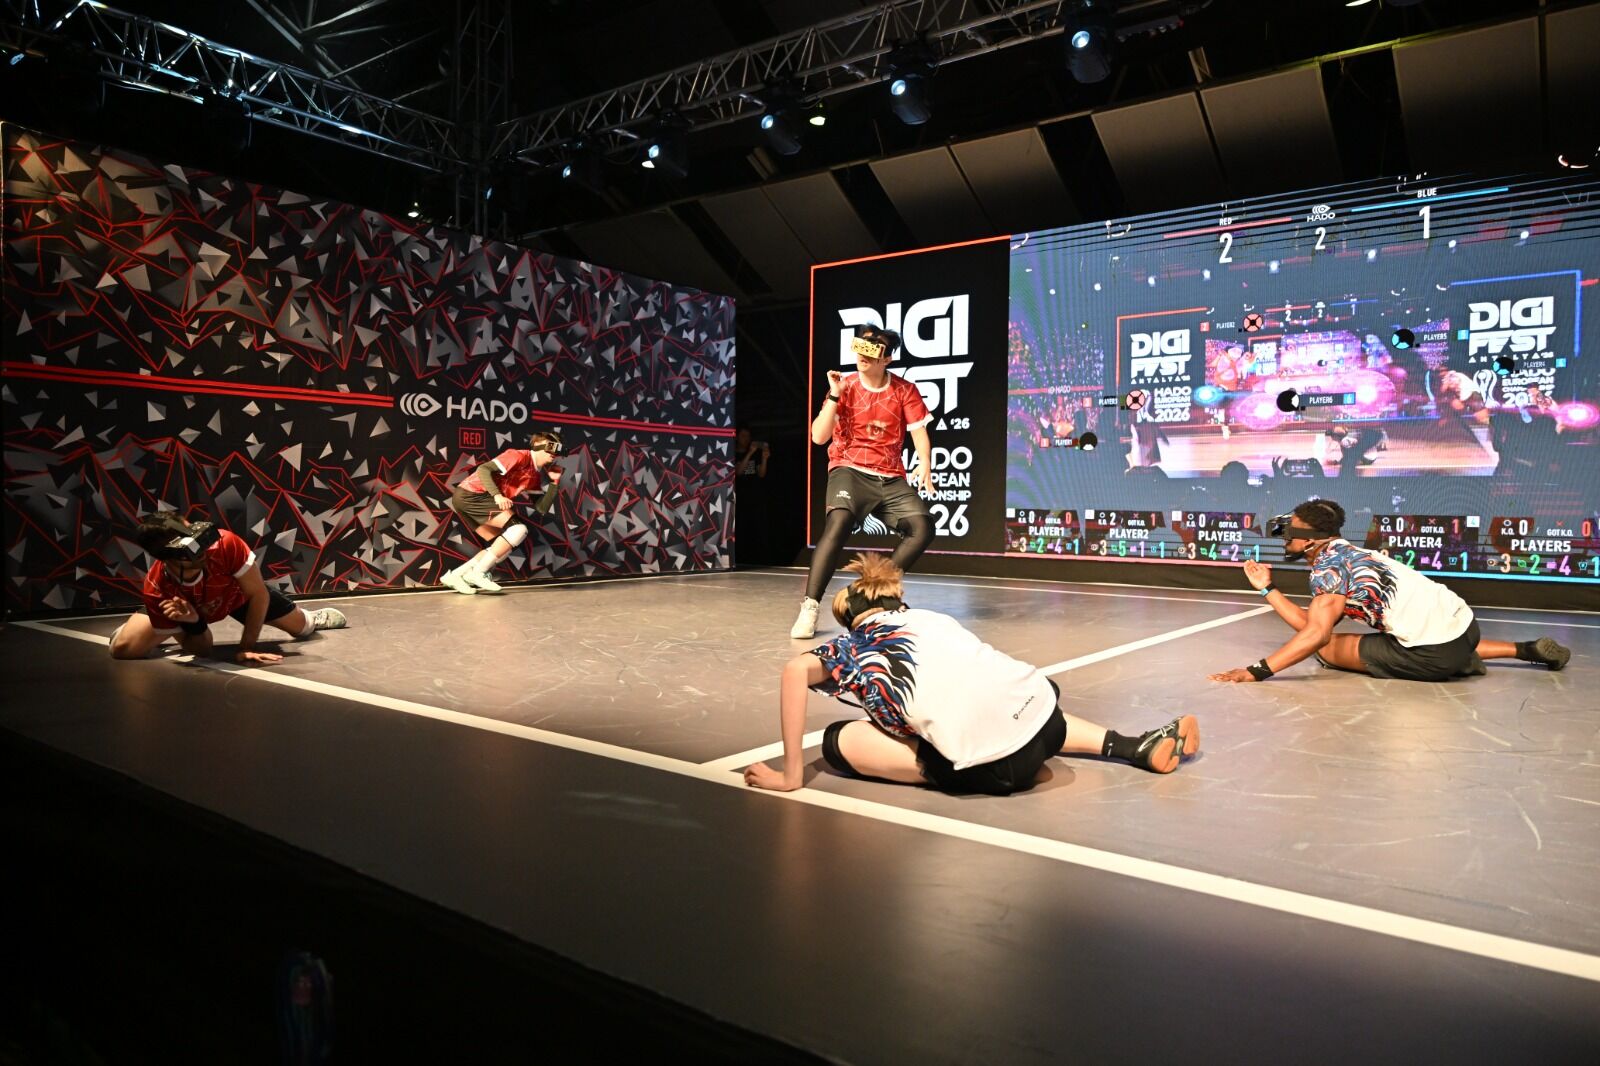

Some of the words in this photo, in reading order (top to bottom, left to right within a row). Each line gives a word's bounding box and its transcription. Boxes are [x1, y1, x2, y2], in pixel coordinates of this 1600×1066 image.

[1417, 188, 1437, 198] BLUE
[1219, 217, 1232, 226] RED
[1306, 212, 1336, 222] HADO
[1419, 205, 1431, 239] 1
[1315, 227, 1326, 250] 2
[1219, 232, 1233, 264] 2
[1468, 296, 1554, 331] DIGI
[838, 294, 970, 366] DIGI
[1130, 329, 1190, 358] DIGI
[1469, 327, 1557, 357] FEST
[1469, 352, 1540, 364] ANTLYA
[841, 362, 974, 415] ST
[1154, 386, 1192, 397] HADO
[446, 396, 528, 425] HADO
[1154, 407, 1191, 422] 2026
[463, 432, 481, 445] RED
[905, 472, 971, 488] PEAN
[918, 489, 972, 502] PIONSHIP
[929, 503, 970, 537] 26
[1029, 511, 1035, 523] 0
[1065, 512, 1072, 524] 0
[1110, 512, 1116, 525] 2
[1151, 513, 1156, 526] 1
[1199, 514, 1206, 528] 0
[1244, 515, 1251, 528] 0
[1396, 517, 1404, 532] 0
[1452, 519, 1459, 534] 1
[1029, 526, 1065, 536] PLAYER1
[1110, 528, 1149, 539] PLAYER2
[1519, 519, 1528, 535] 0
[1582, 521, 1591, 537] 0
[1198, 531, 1242, 542] PLAYER3
[1388, 536, 1442, 548] PLAYER4
[1020, 537, 1027, 552] 3
[1037, 538, 1044, 553] 2
[1054, 538, 1062, 554] 4
[1073, 539, 1079, 554] 1
[1100, 540, 1107, 555] 3
[1119, 541, 1126, 556] 5
[1139, 541, 1145, 557] 1
[1159, 542, 1165, 558] 1
[1188, 543, 1196, 559] 3
[1209, 544, 1217, 560] 4
[1231, 544, 1239, 561] 2
[1254, 545, 1260, 562] 1
[1511, 539, 1571, 552] PLAYER5
[1406, 550, 1415, 569] 2
[1432, 551, 1442, 570] 4
[1460, 552, 1468, 571] 1
[1501, 553, 1511, 573] 3
[1529, 555, 1540, 574] 2
[1559, 555, 1571, 576] 4
[1591, 556, 1600, 577] 1
